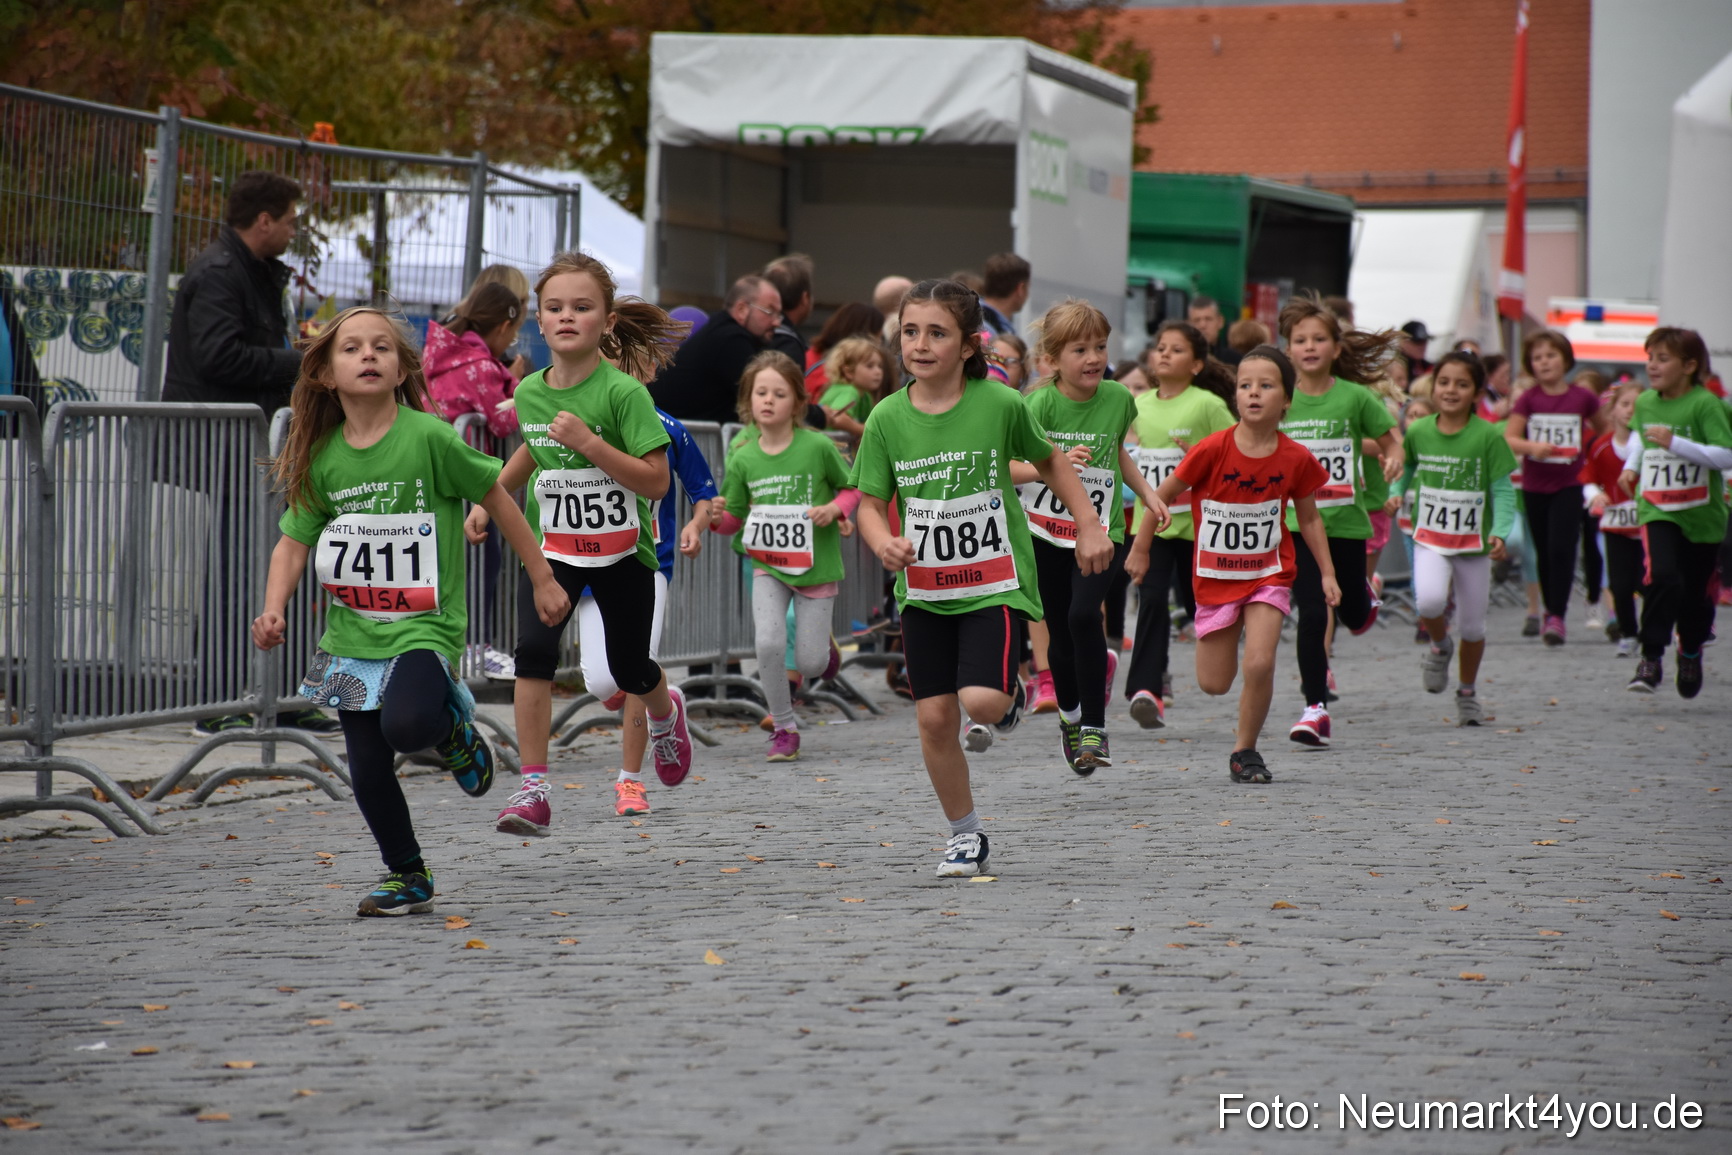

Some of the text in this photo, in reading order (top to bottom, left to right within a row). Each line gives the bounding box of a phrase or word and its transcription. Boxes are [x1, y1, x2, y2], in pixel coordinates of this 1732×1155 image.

[1532, 427, 1573, 444] 7151
[895, 451, 967, 472] Neumarkter
[566, 477, 615, 488] Neumarkt
[897, 466, 952, 487] Stadtlauf
[1649, 463, 1700, 487] 7147
[545, 490, 628, 529] 7053
[907, 503, 988, 520] PARTL Neumarkt
[1425, 503, 1476, 531] 7414
[325, 525, 413, 536] PARTL Neumarkt
[751, 522, 806, 548] 7038
[914, 516, 1002, 562] 7084
[1207, 520, 1274, 550] 7057
[575, 538, 601, 553] Lisa
[329, 541, 420, 581] 7411
[765, 554, 788, 565] Maya
[1217, 557, 1264, 569] Marlene
[935, 569, 983, 586] Emilia
